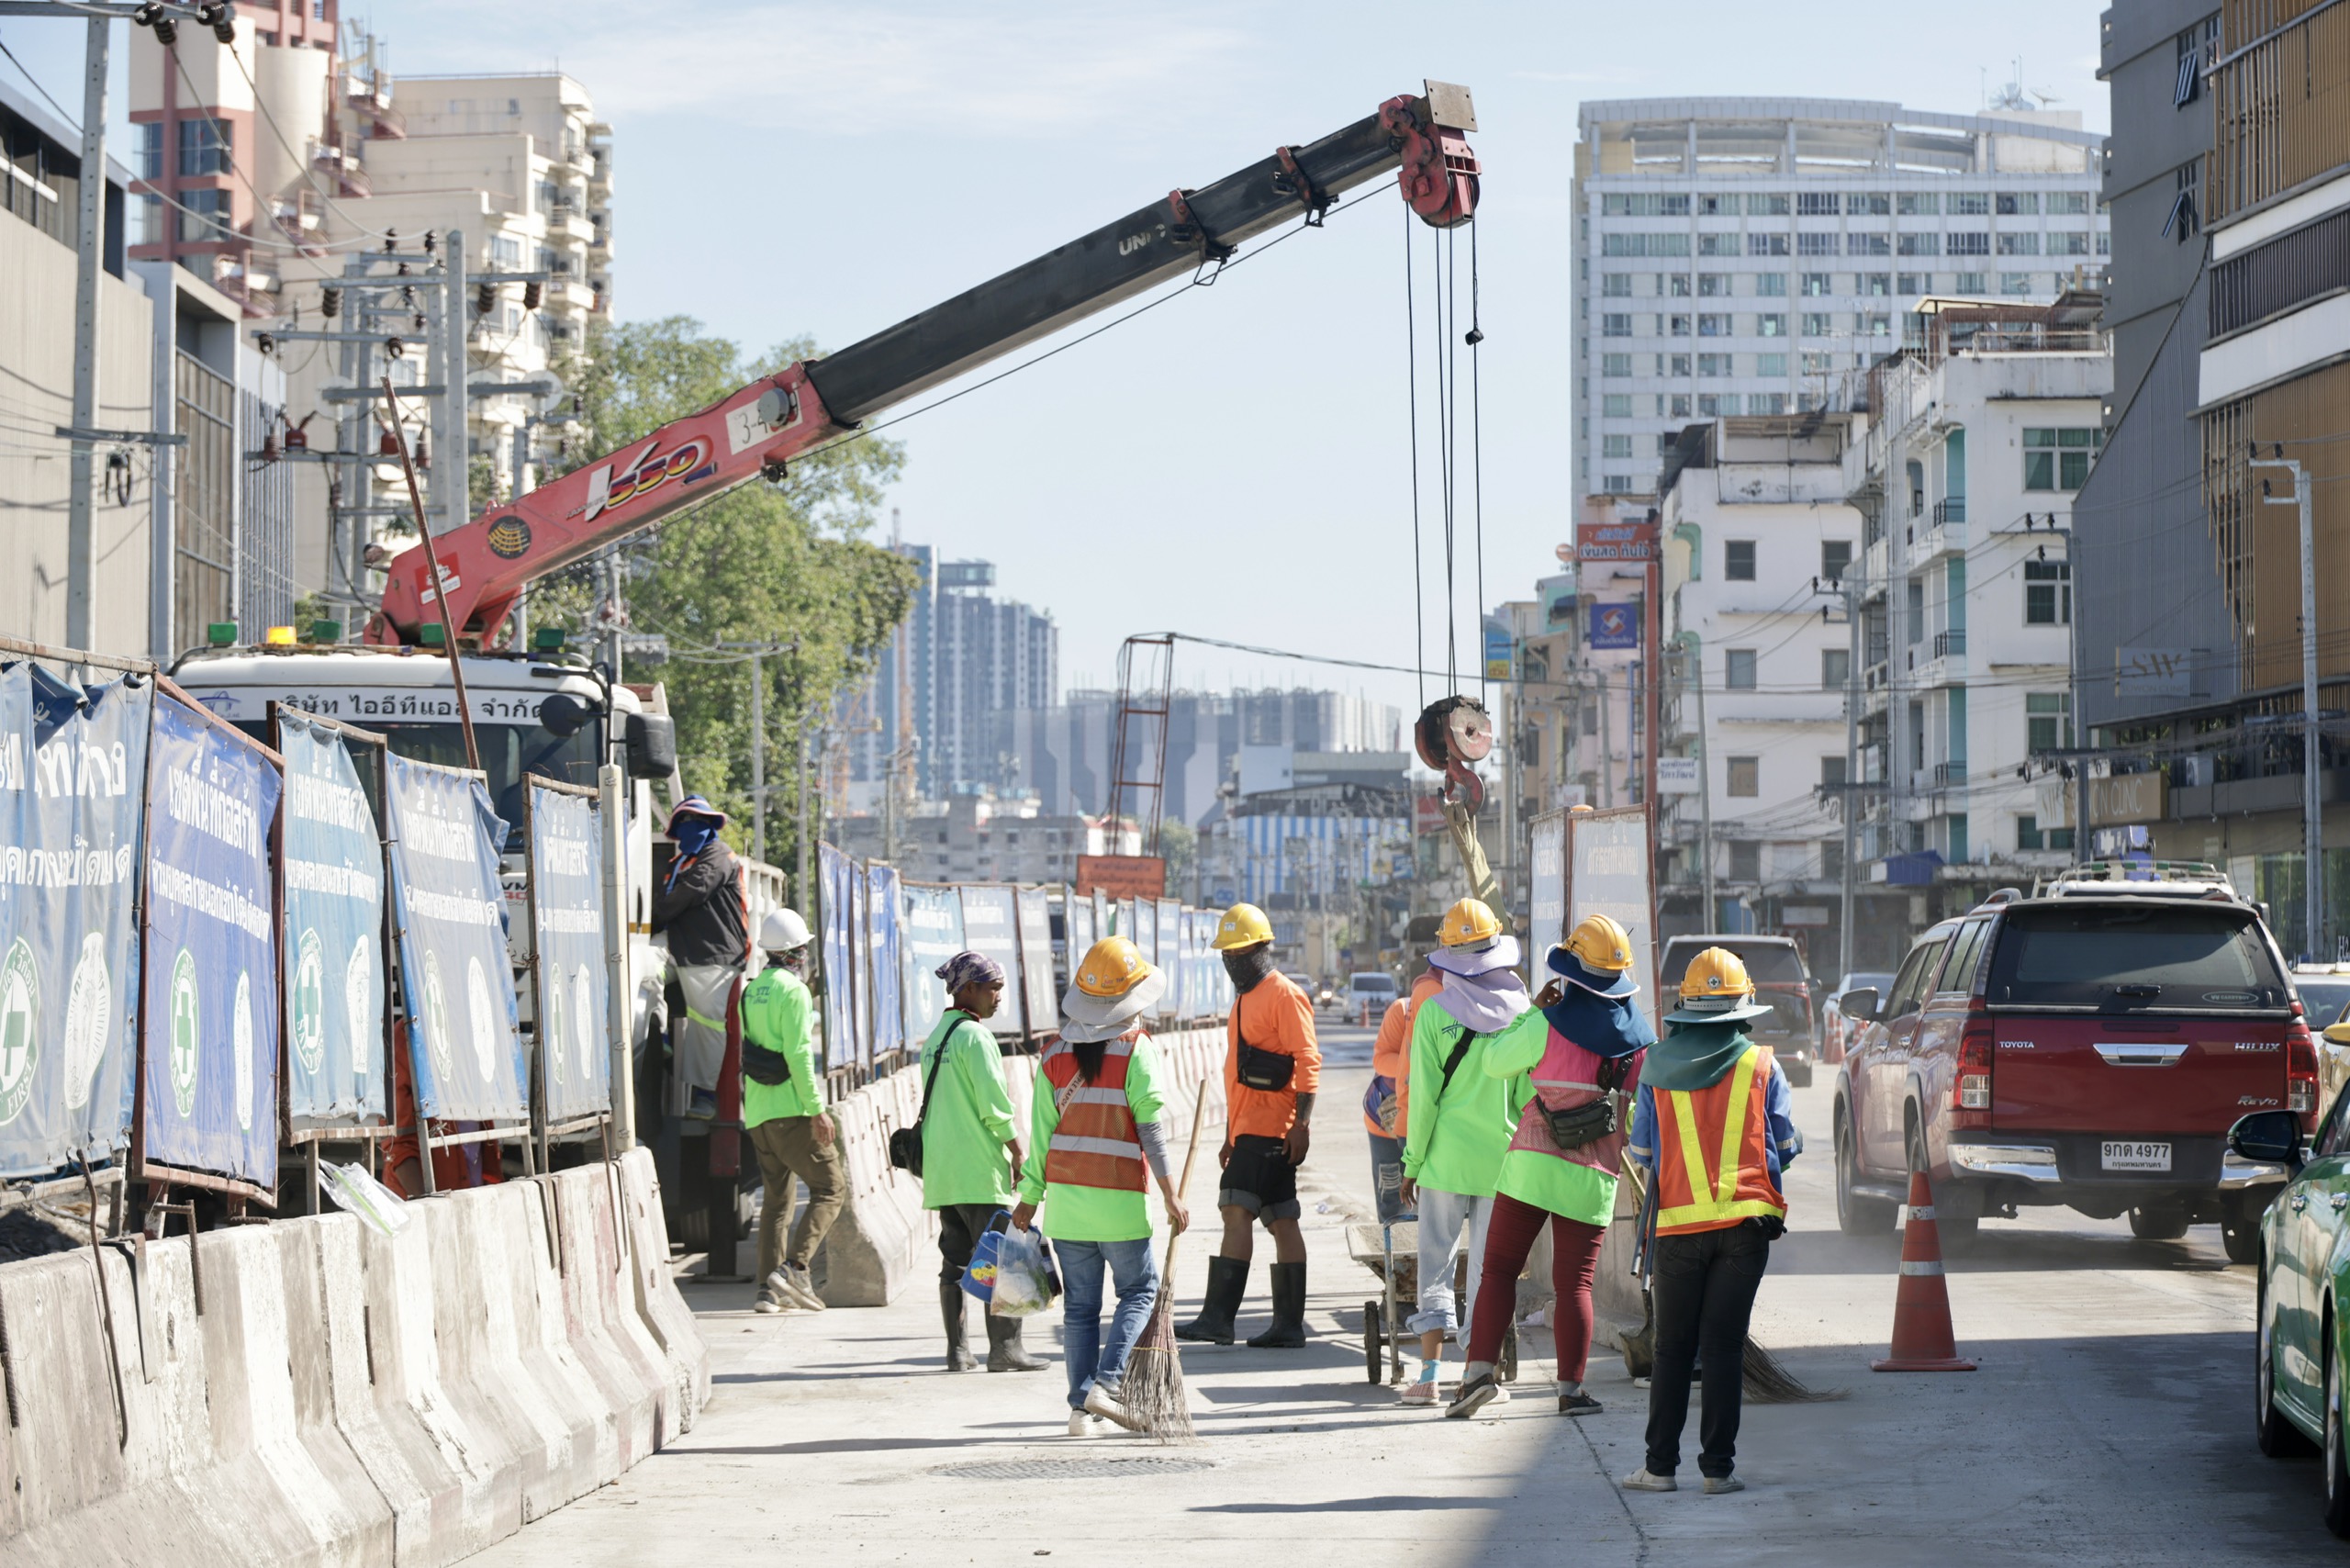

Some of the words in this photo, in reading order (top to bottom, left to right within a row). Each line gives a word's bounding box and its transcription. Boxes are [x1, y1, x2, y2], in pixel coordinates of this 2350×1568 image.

[2132, 653, 2182, 678] SW
[278, 694, 339, 714] ริษัท
[168, 741, 258, 859] เขตพื้นที่ก่อสร้าง
[2070, 780, 2109, 821] SON
[2111, 778, 2143, 817] CLINIC
[1999, 1041, 2034, 1049] TOYOTA
[2233, 1042, 2280, 1052] HILUX
[2104, 1143, 2132, 1158] 9กด
[2136, 1144, 2169, 1159] 4977
[2112, 1160, 2162, 1170] กรุงเทพมหานคร
